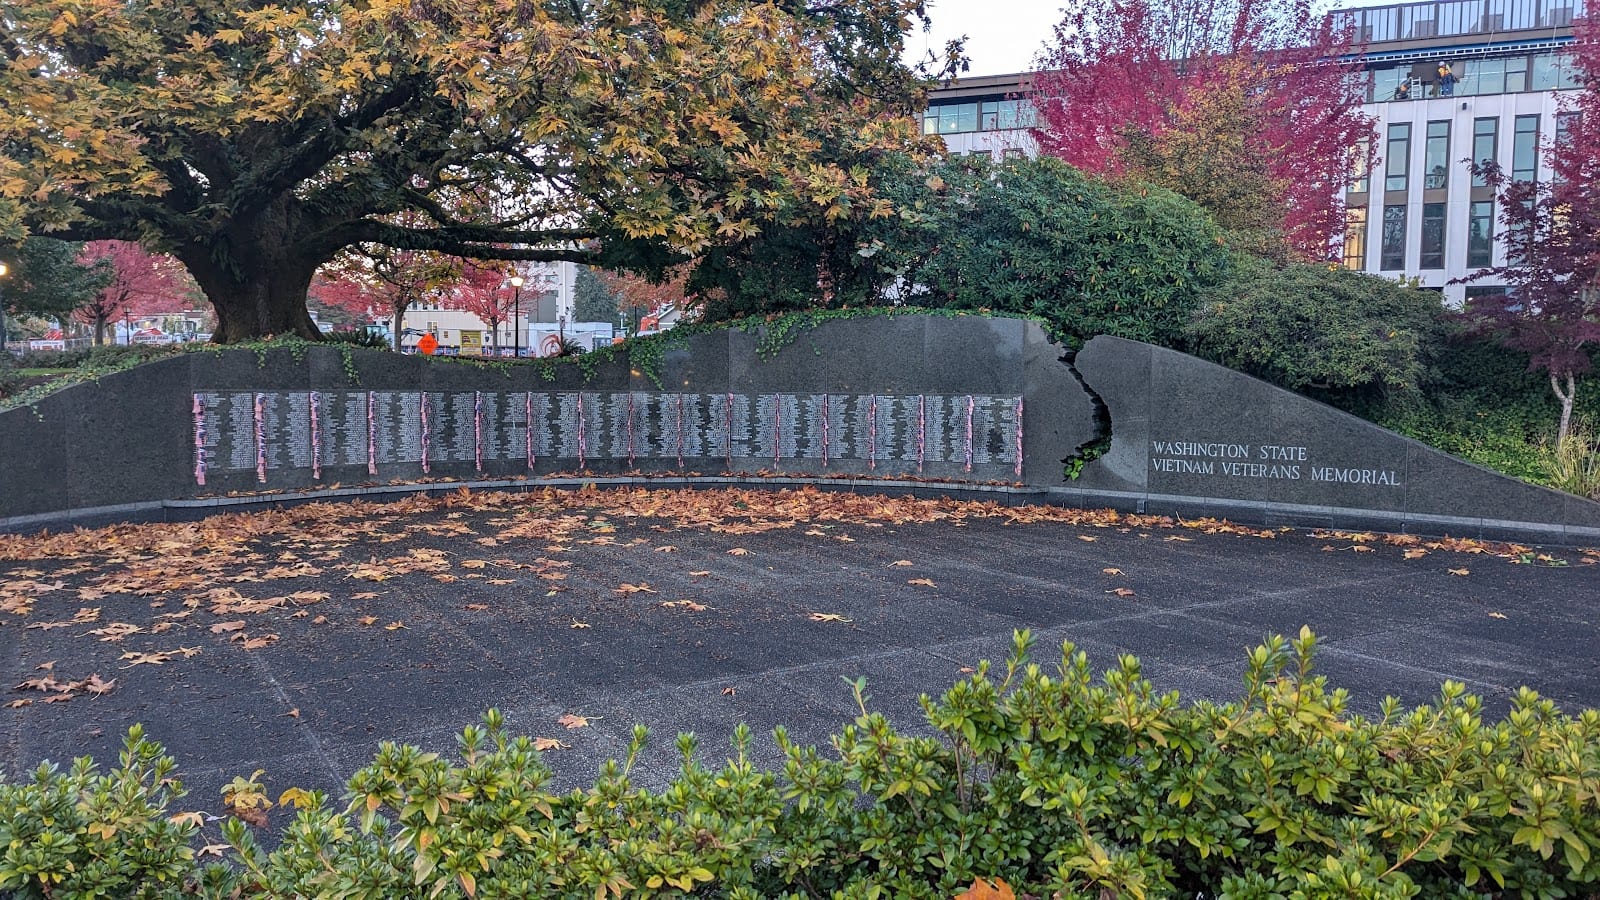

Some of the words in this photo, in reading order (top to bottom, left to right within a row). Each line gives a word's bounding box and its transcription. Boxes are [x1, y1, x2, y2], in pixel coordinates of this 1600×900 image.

[1153, 441, 1249, 458] WASHINGTON
[1260, 445, 1307, 460] STATE
[1153, 458, 1214, 475] VIETNAM
[1222, 462, 1300, 480] VETERANS
[1311, 466, 1401, 486] MEMORIAL
